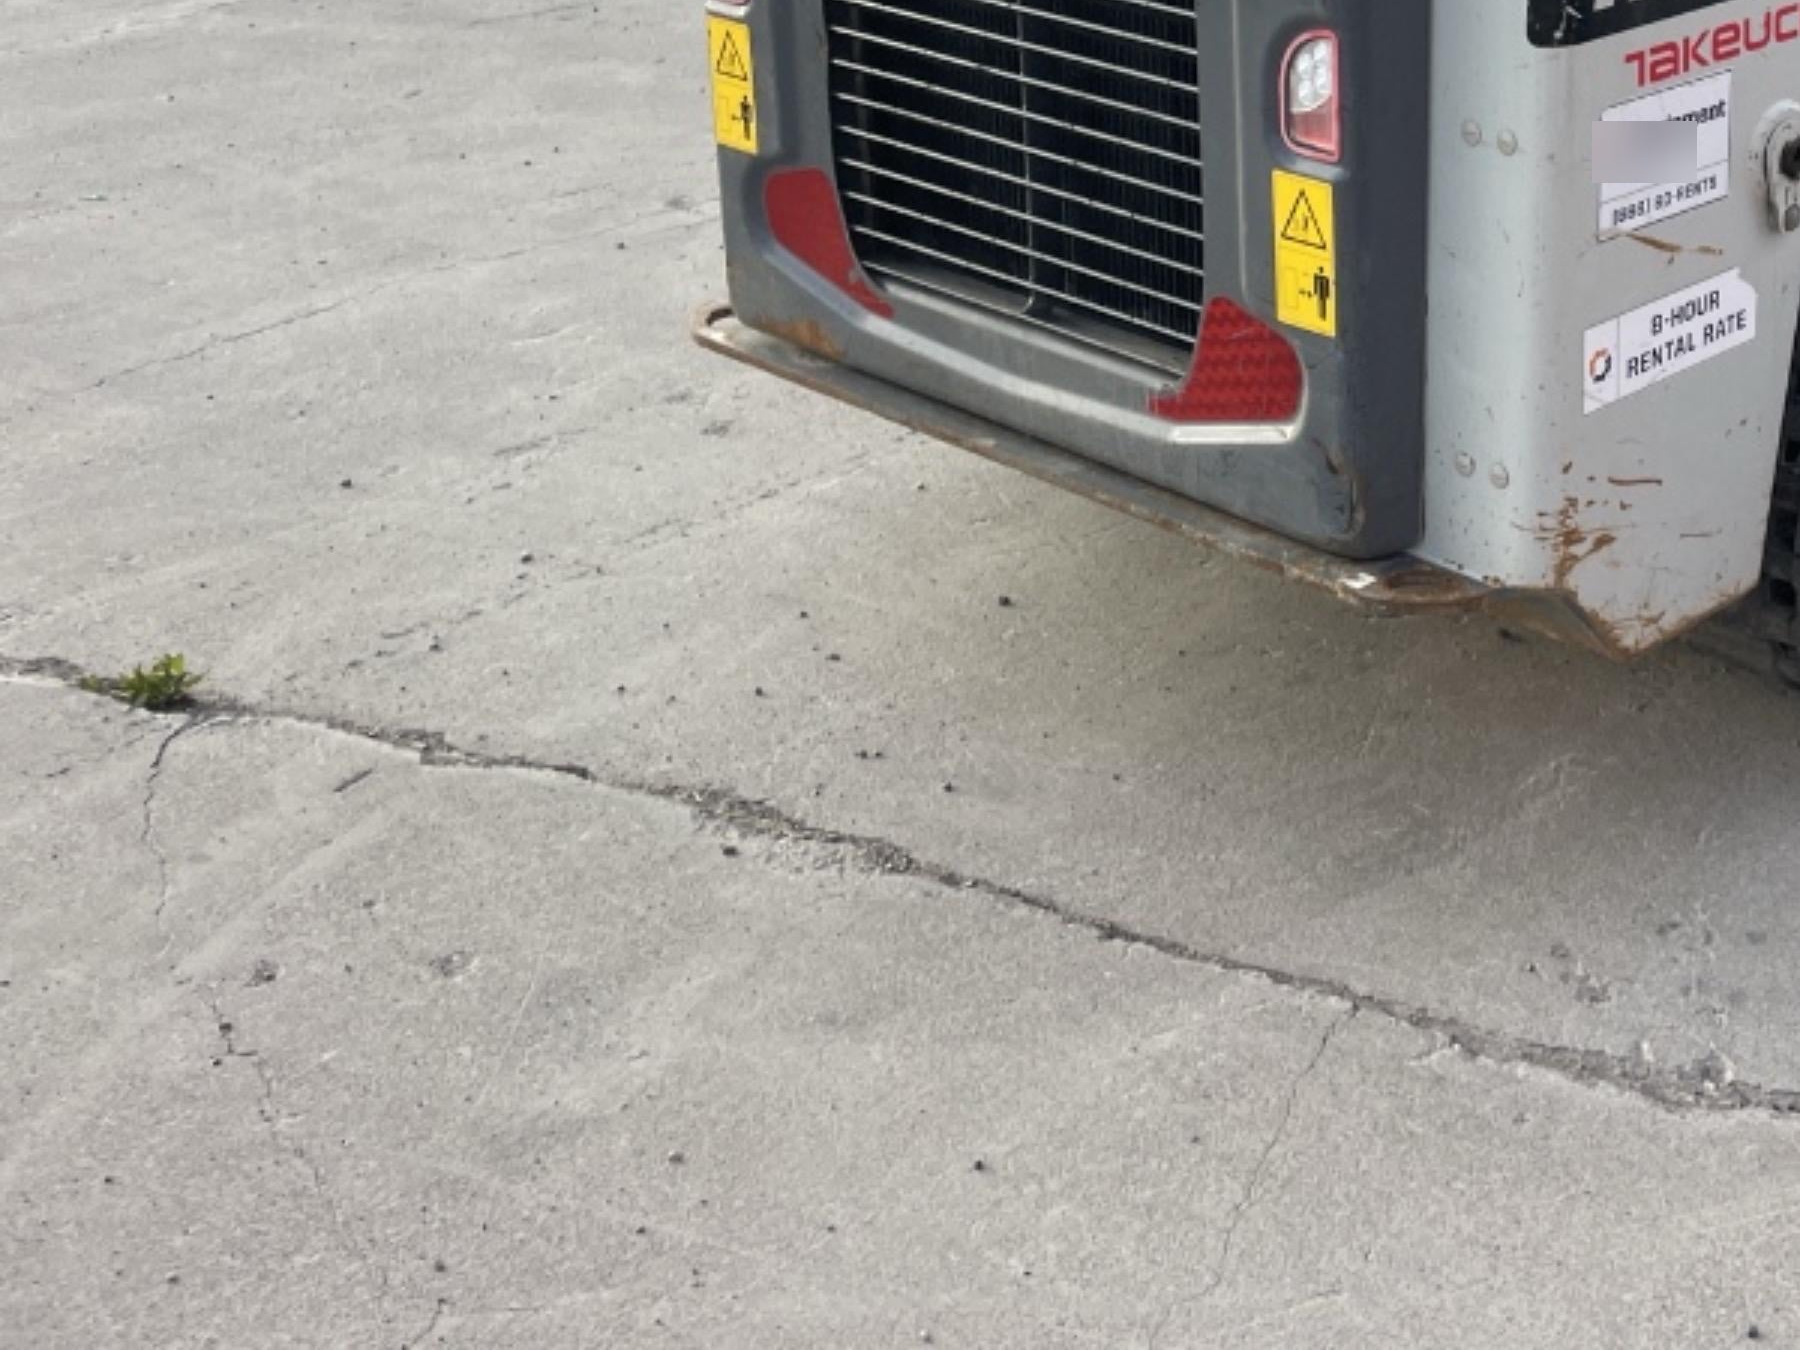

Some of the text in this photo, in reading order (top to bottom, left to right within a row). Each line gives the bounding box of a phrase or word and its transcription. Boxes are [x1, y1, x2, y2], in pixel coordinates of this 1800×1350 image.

[1651, 289, 1721, 337] 8-HOUR
[1625, 308, 1748, 379] RENTAL RATE
